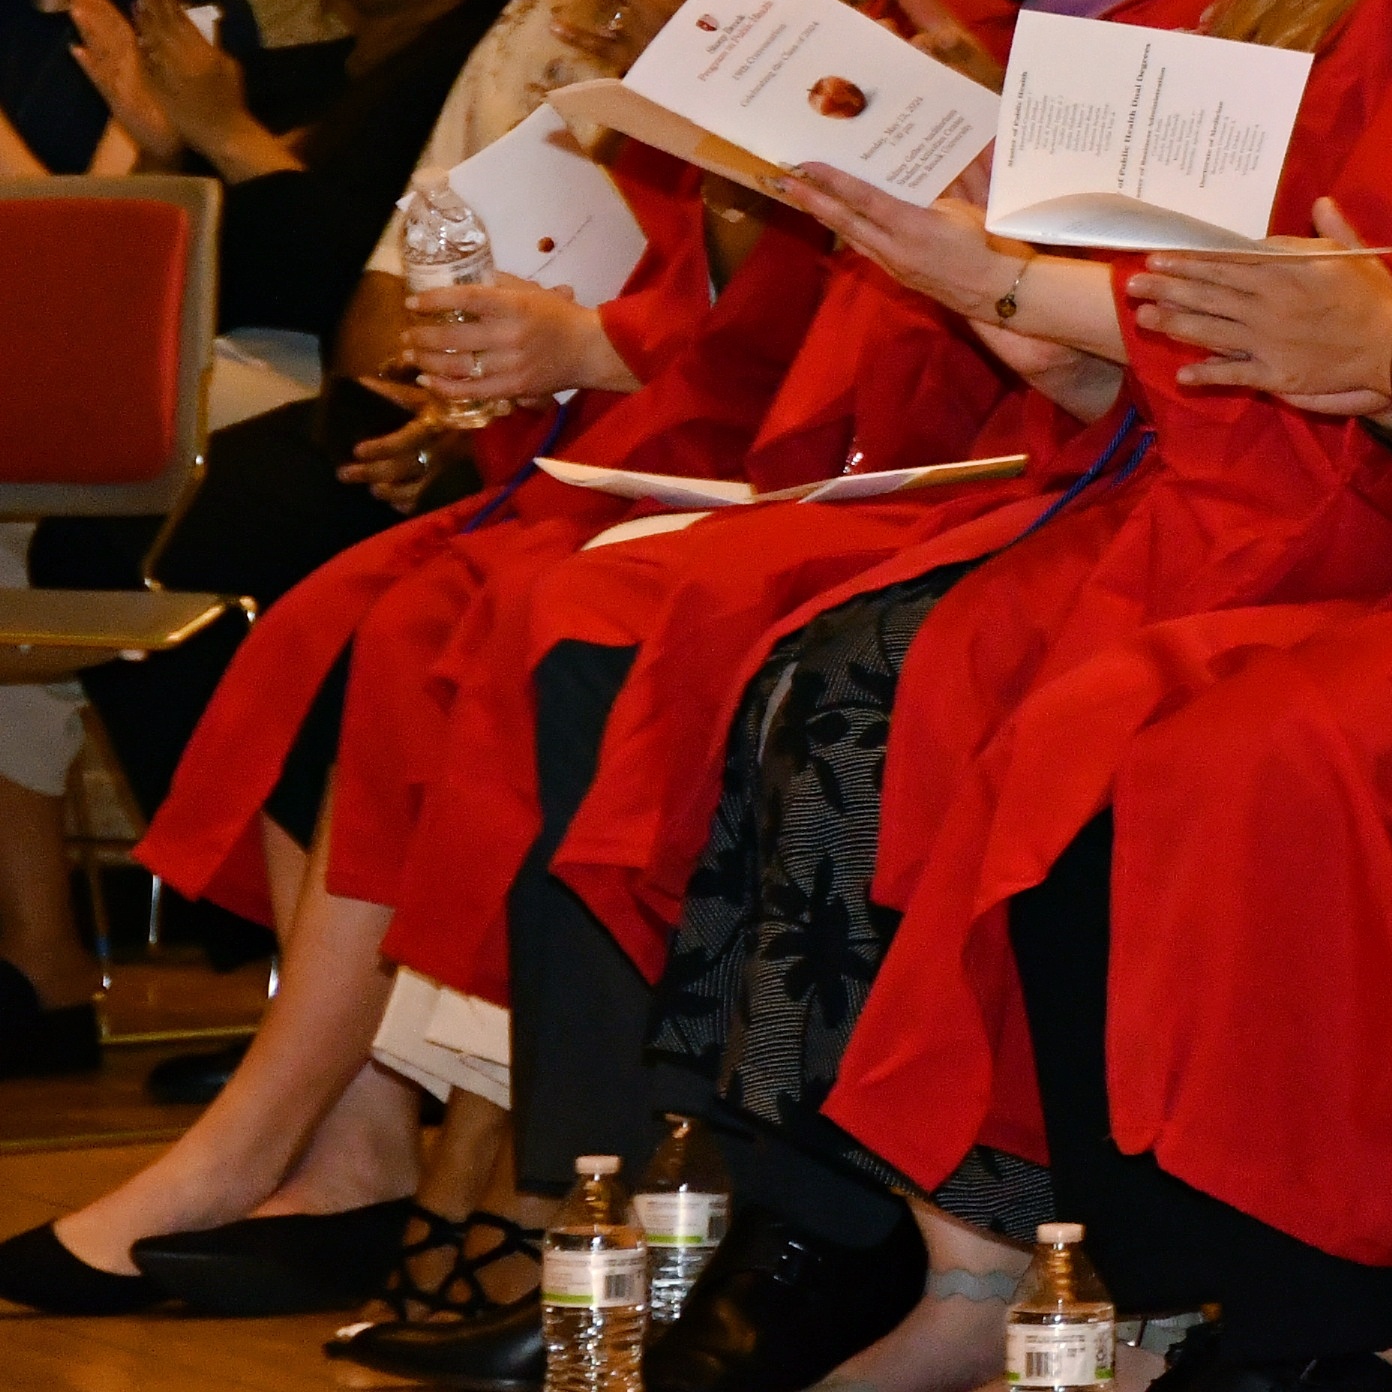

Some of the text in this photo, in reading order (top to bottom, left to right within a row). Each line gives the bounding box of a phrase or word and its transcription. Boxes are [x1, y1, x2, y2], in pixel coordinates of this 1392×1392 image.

[1123, 108, 1137, 142] Health
[1130, 84, 1142, 107] Dual
[1136, 42, 1152, 82] Degrees
